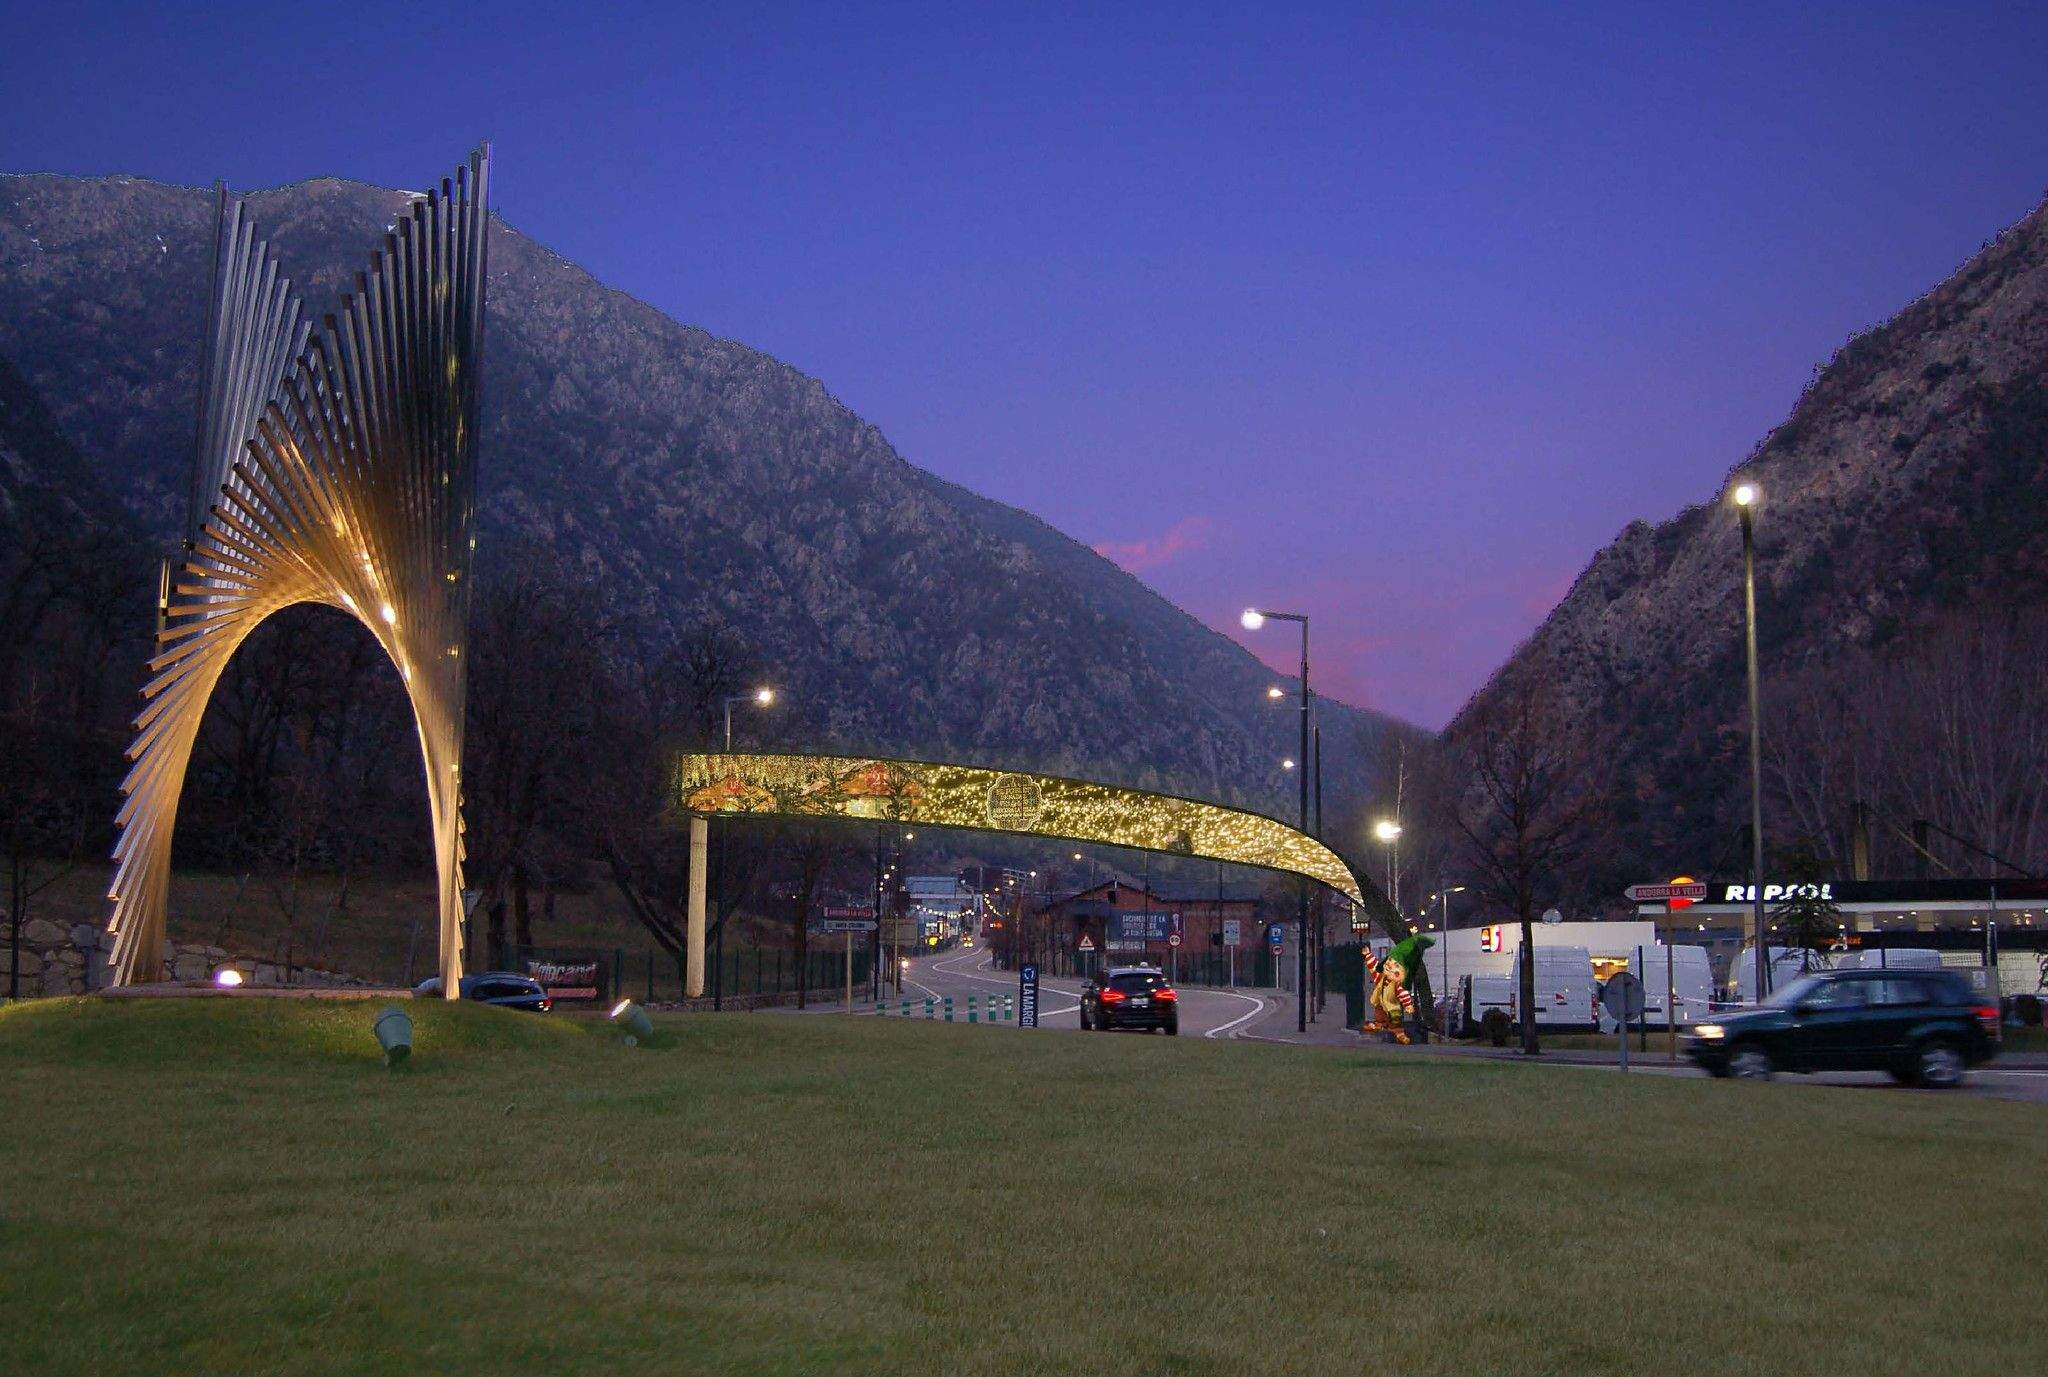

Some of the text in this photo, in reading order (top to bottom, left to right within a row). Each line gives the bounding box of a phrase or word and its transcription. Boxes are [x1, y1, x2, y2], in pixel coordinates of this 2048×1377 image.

[1637, 886, 1704, 897] ANDORRA LA VELLA
